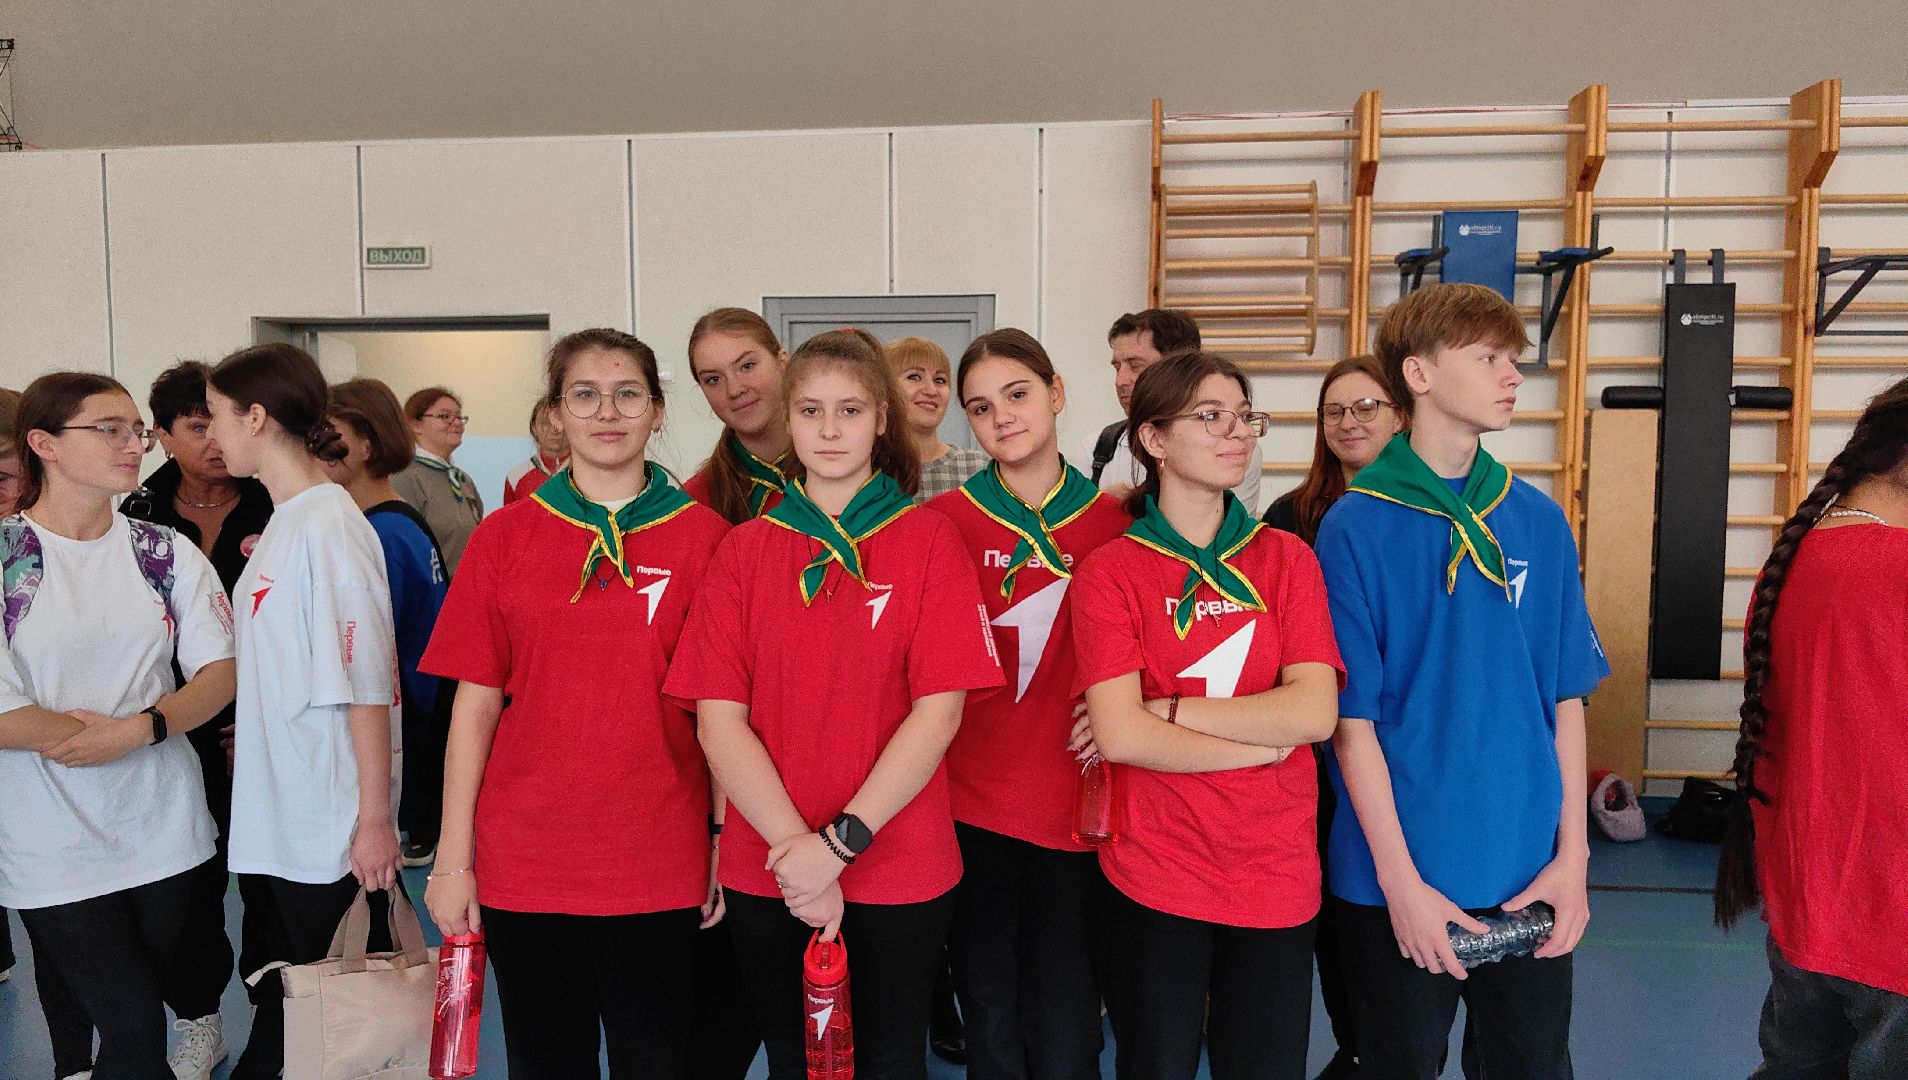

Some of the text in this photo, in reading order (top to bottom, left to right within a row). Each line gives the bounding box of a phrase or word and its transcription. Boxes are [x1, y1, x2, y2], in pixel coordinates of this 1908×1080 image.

[369, 248, 422, 262] ВЫХОД
[983, 549, 1074, 569] Певе
[636, 565, 672, 576] Первые
[1165, 596, 1253, 621] Првы
[345, 620, 356, 664] Первые
